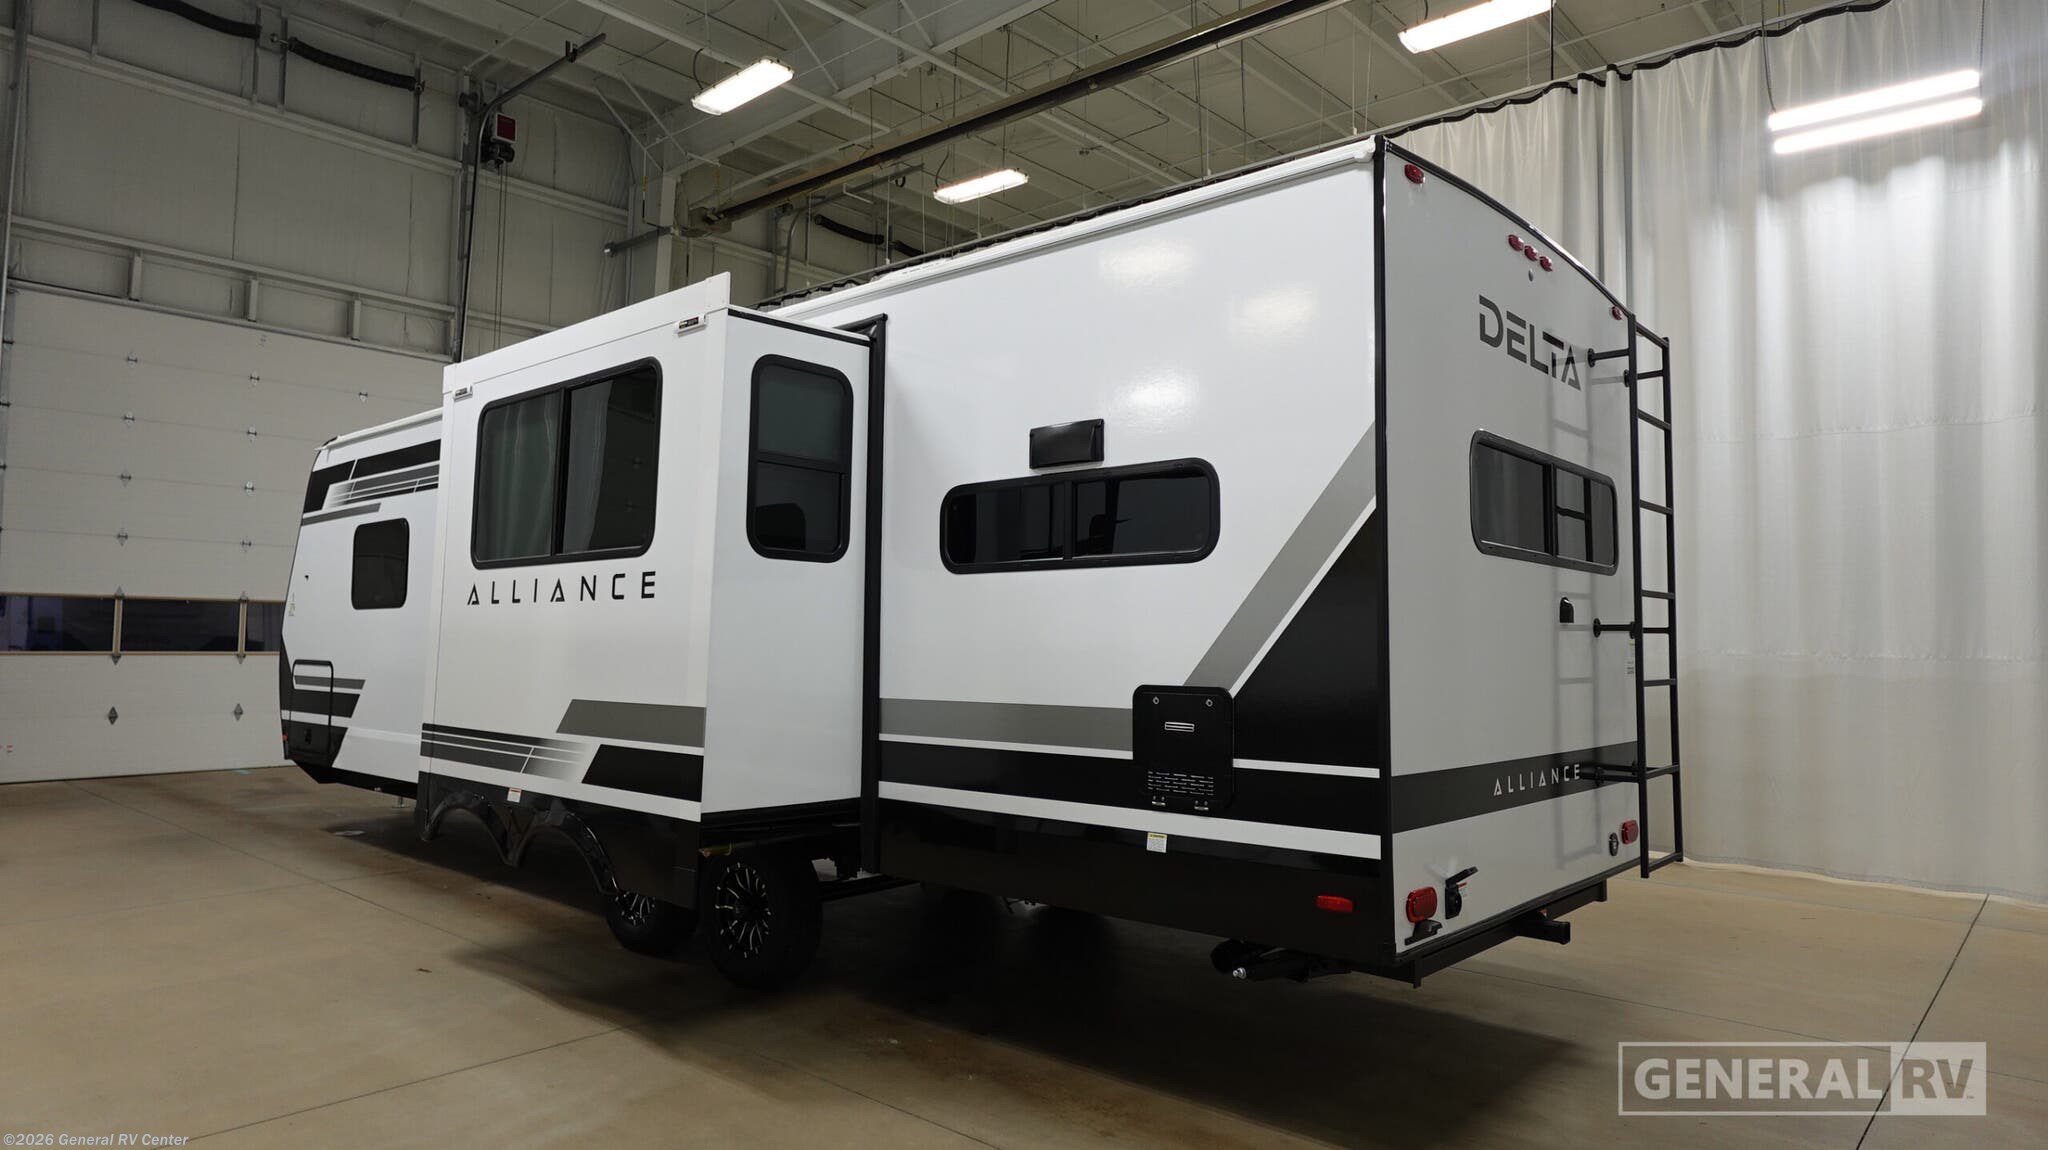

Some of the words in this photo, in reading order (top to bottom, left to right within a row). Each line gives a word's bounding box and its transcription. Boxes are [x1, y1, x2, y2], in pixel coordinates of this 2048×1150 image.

[1479, 294, 1581, 391] DELTA
[467, 571, 656, 605] ALLIANCE
[1494, 764, 1580, 796] ALLIANCE
